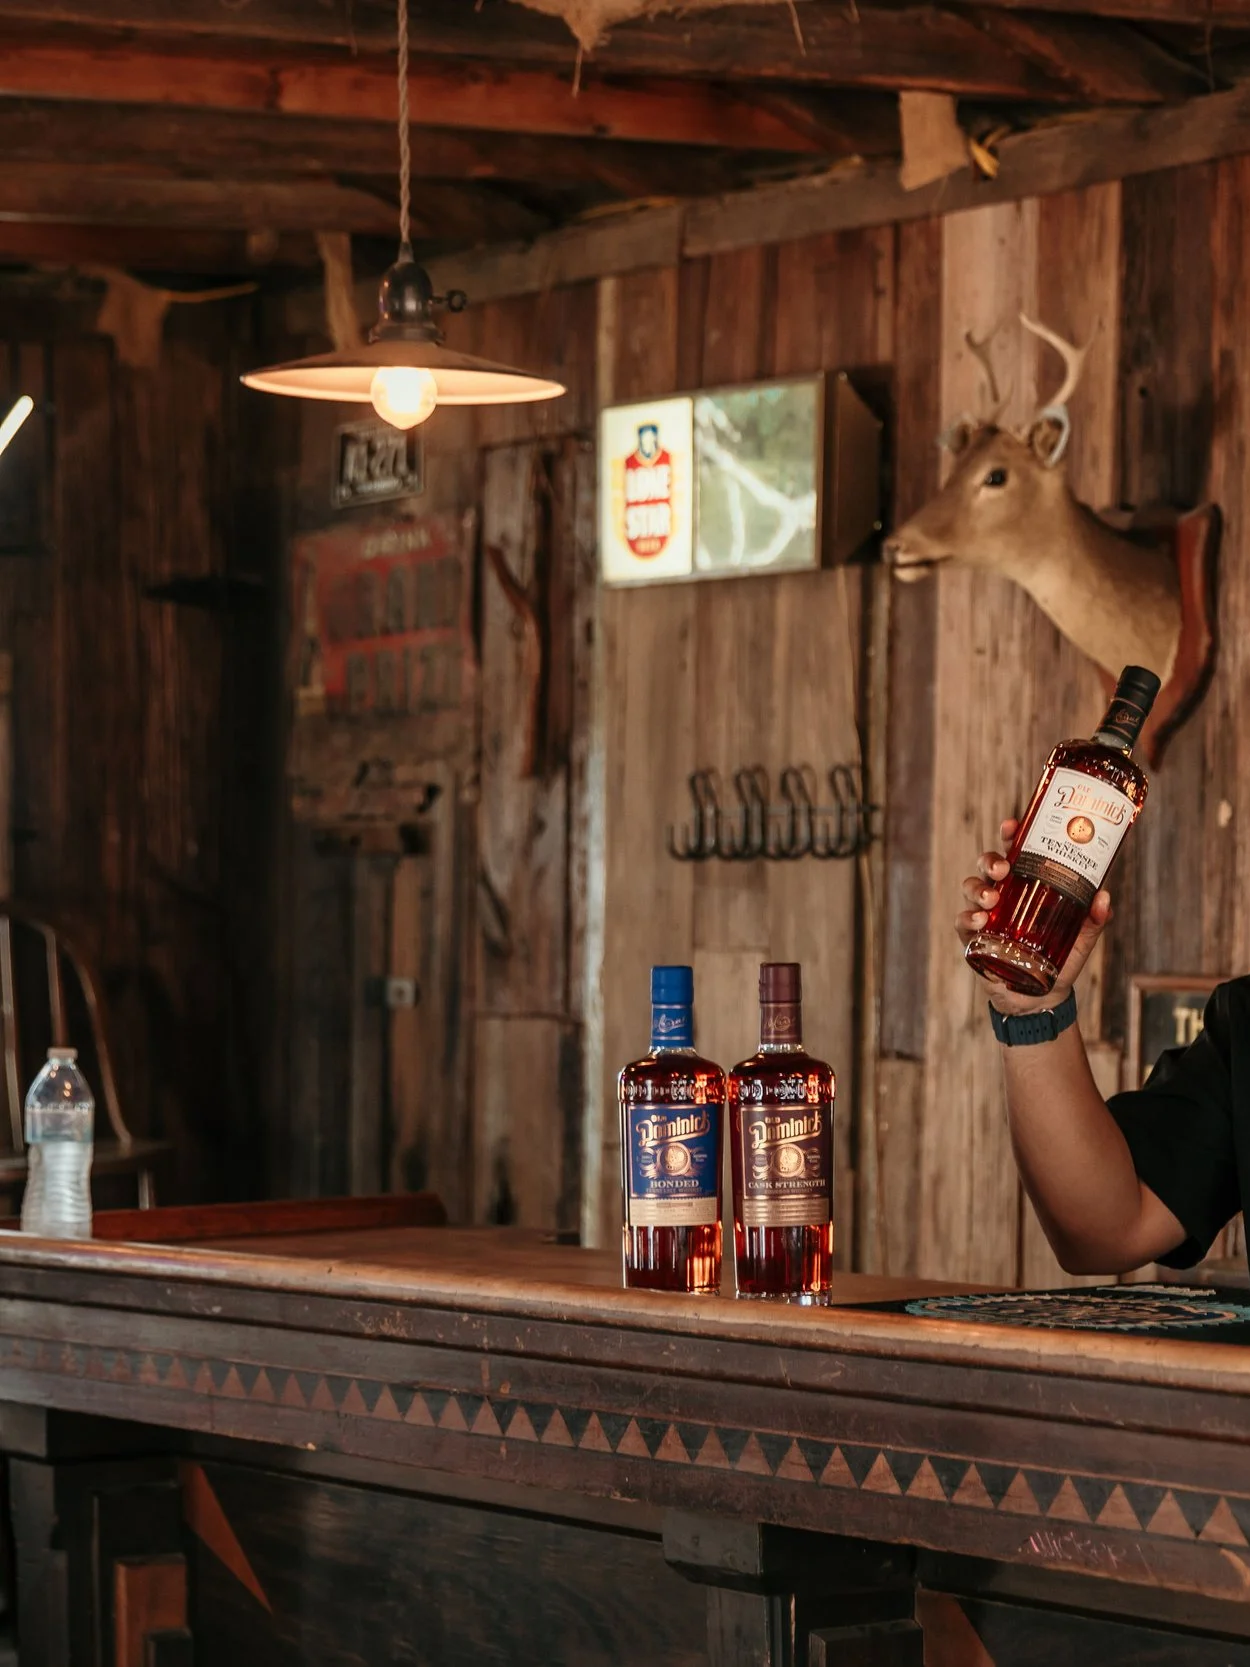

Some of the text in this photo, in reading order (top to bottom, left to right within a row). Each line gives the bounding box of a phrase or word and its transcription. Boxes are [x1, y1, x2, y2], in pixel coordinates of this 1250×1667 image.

[1040, 835, 1099, 871] TENNESSEE
[1047, 844, 1091, 871] WHISKEY
[650, 1179, 700, 1189] BONDED
[775, 1179, 826, 1189] STRENGTH
